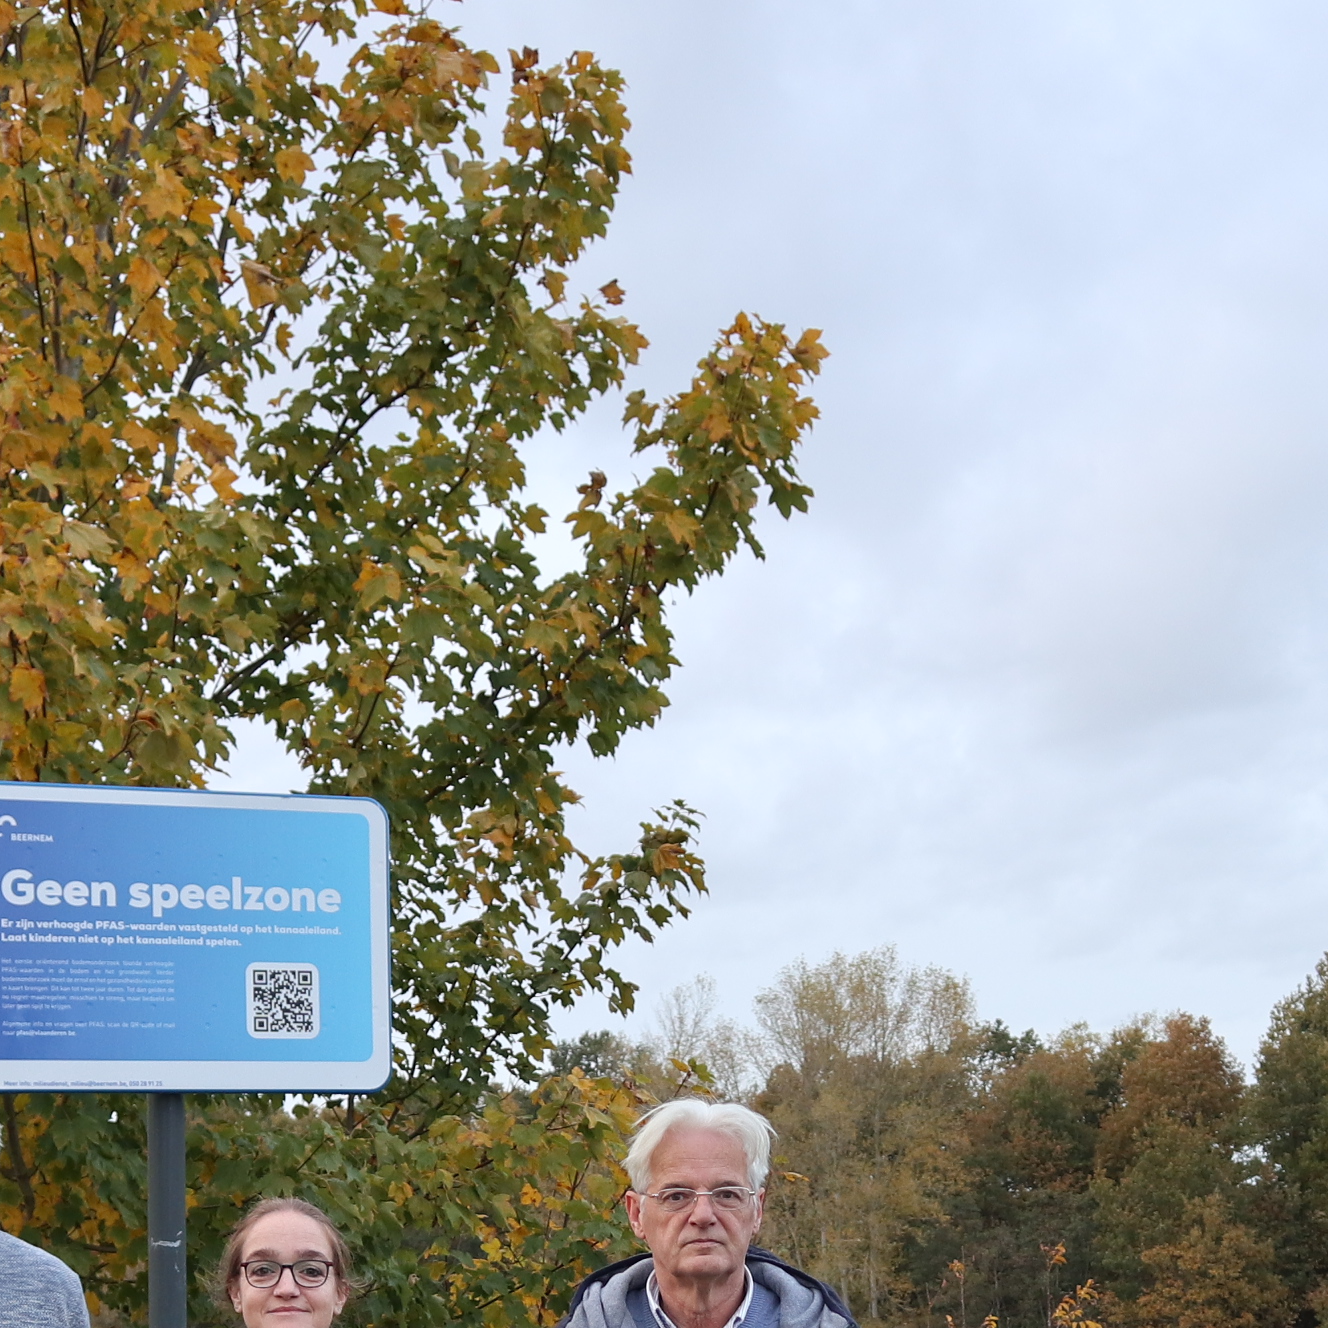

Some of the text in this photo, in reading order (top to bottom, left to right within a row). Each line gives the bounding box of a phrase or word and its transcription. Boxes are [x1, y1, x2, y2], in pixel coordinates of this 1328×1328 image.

[11, 833, 54, 842] BEERNEM
[1, 869, 342, 917] Geen speelzone
[1, 918, 342, 935] Er zijn verhoogde PFAS-waarden vastgesteld op het kanaaleiland.
[1, 933, 242, 947] Laat kinderen niet op het kanaaleiland spelen.
